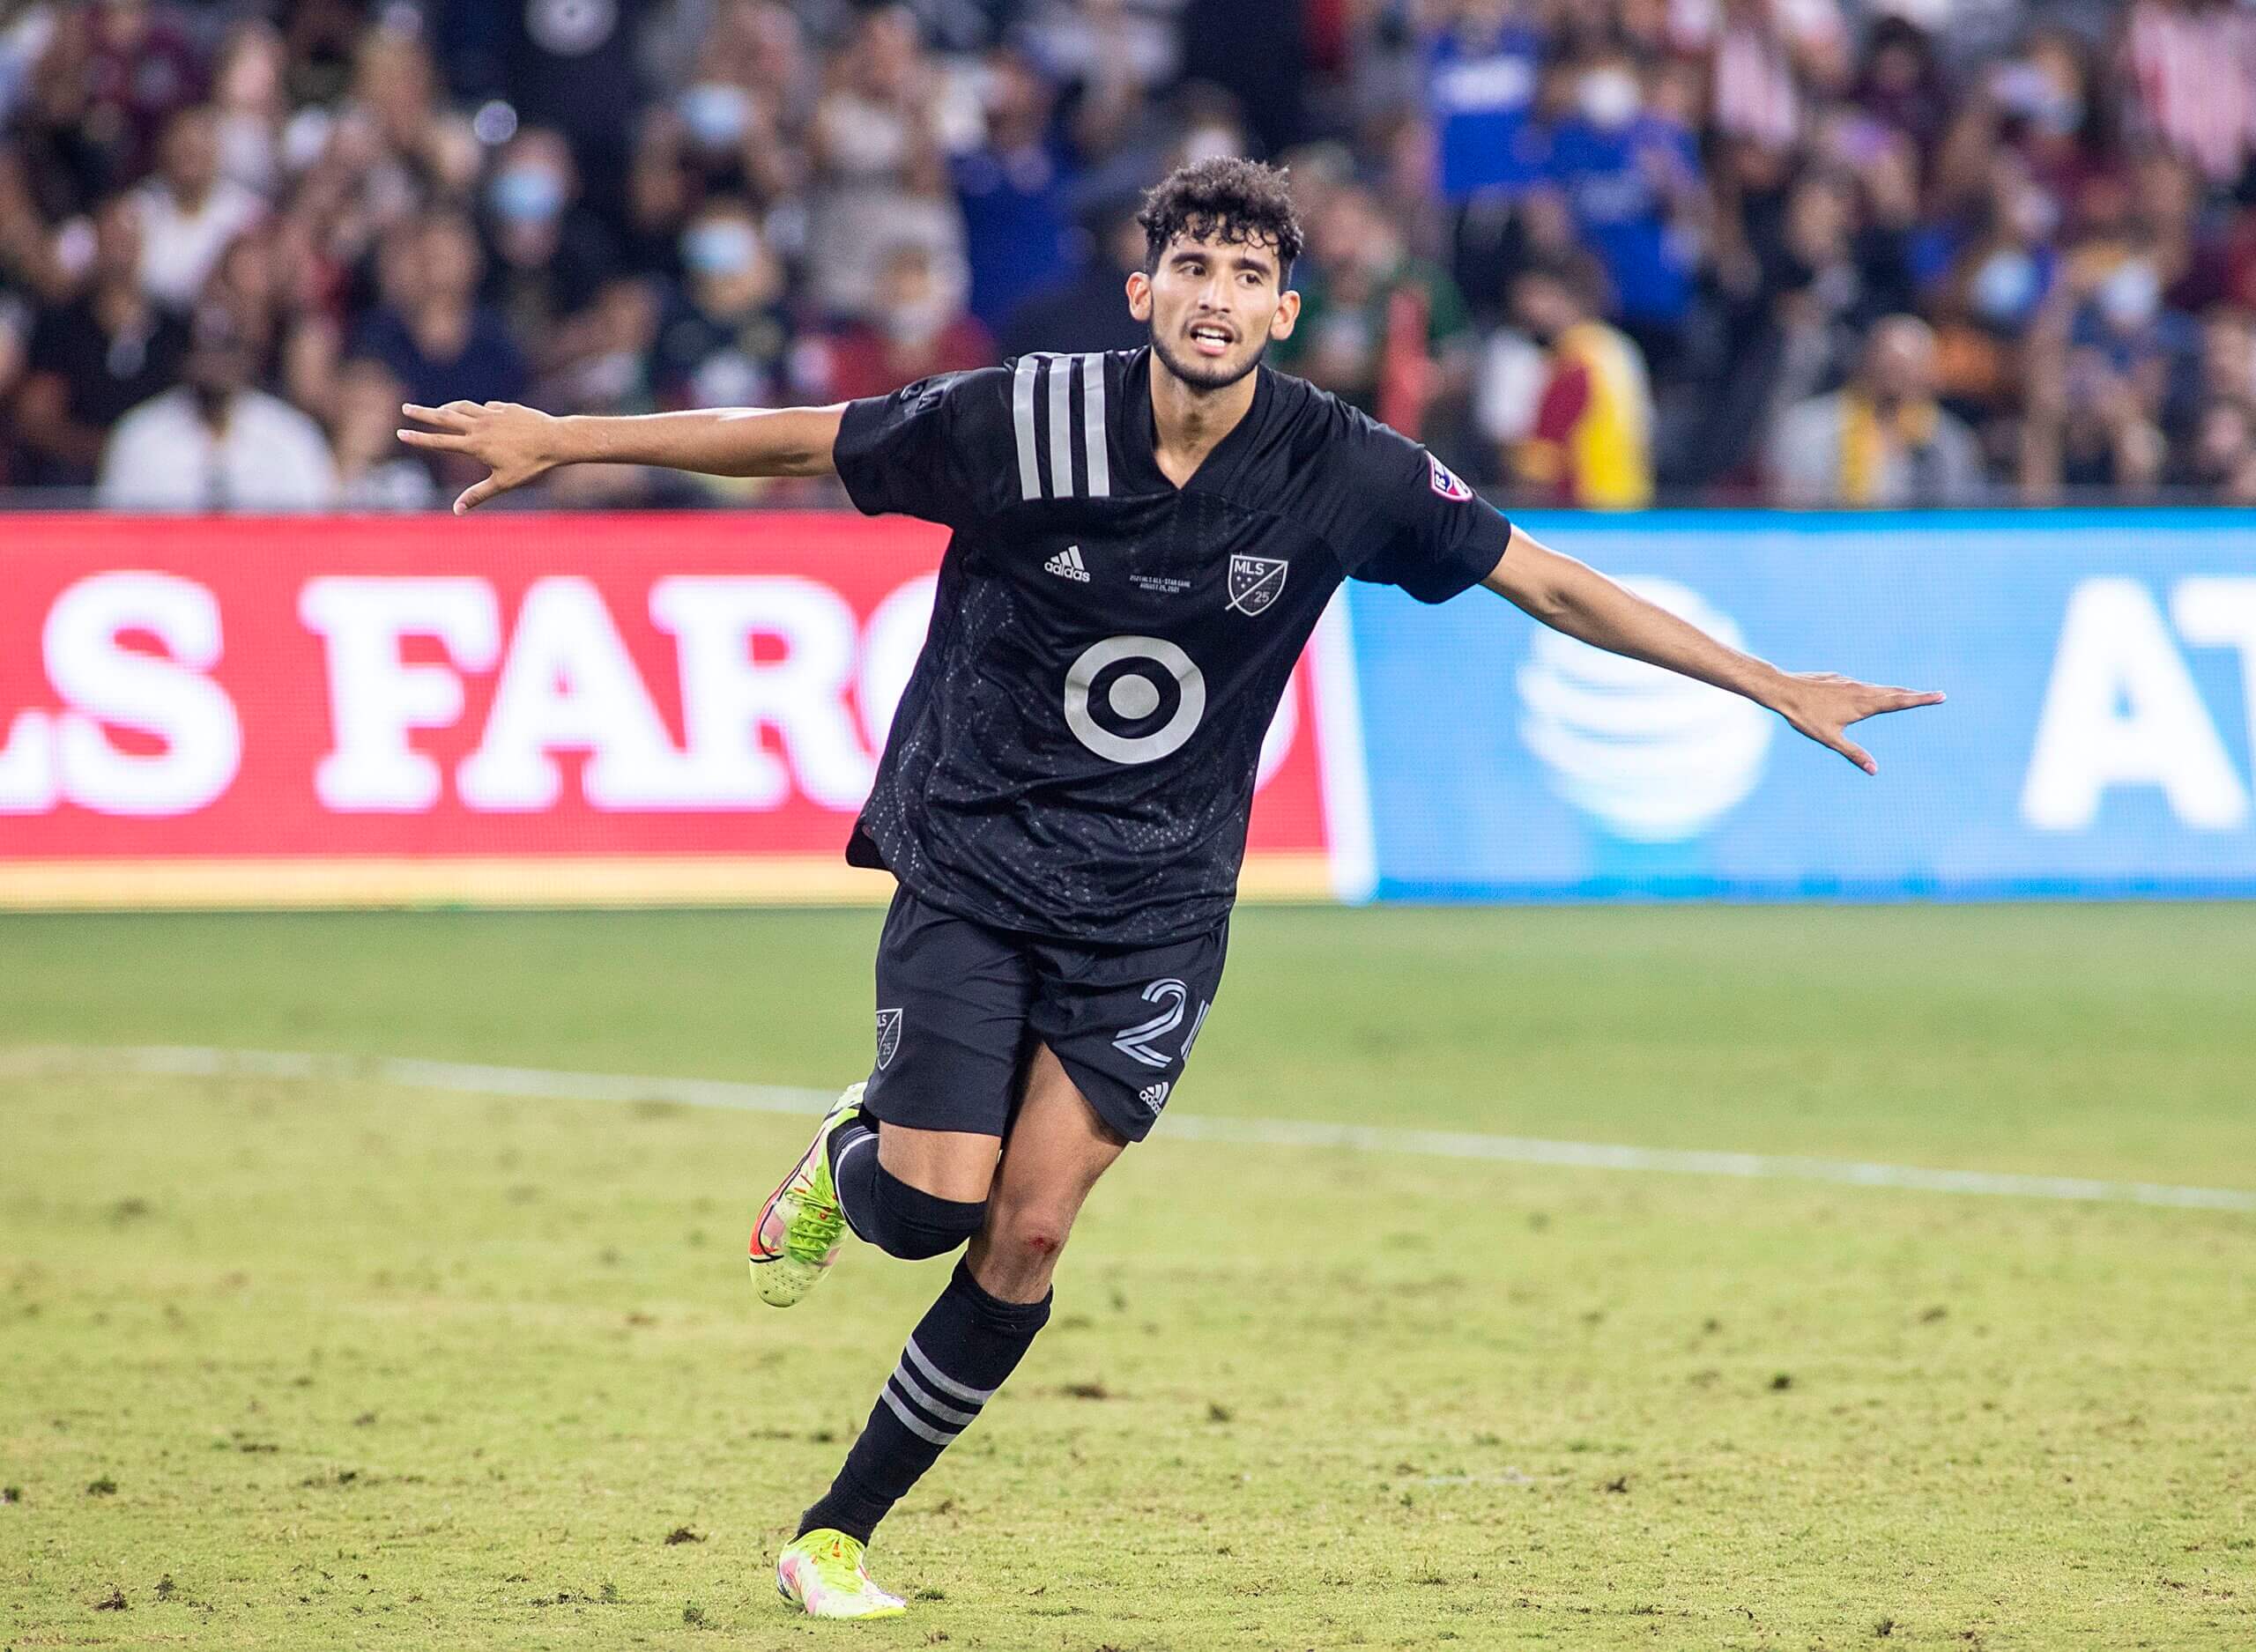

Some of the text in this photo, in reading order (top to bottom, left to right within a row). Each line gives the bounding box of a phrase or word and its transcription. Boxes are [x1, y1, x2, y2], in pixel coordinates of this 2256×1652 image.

[1044, 562, 1091, 583] adidas
[1234, 559, 1265, 576] MLS
[1253, 590, 1271, 604] 25
[877, 1014, 887, 1027] LS
[882, 1042, 891, 1056] 25
